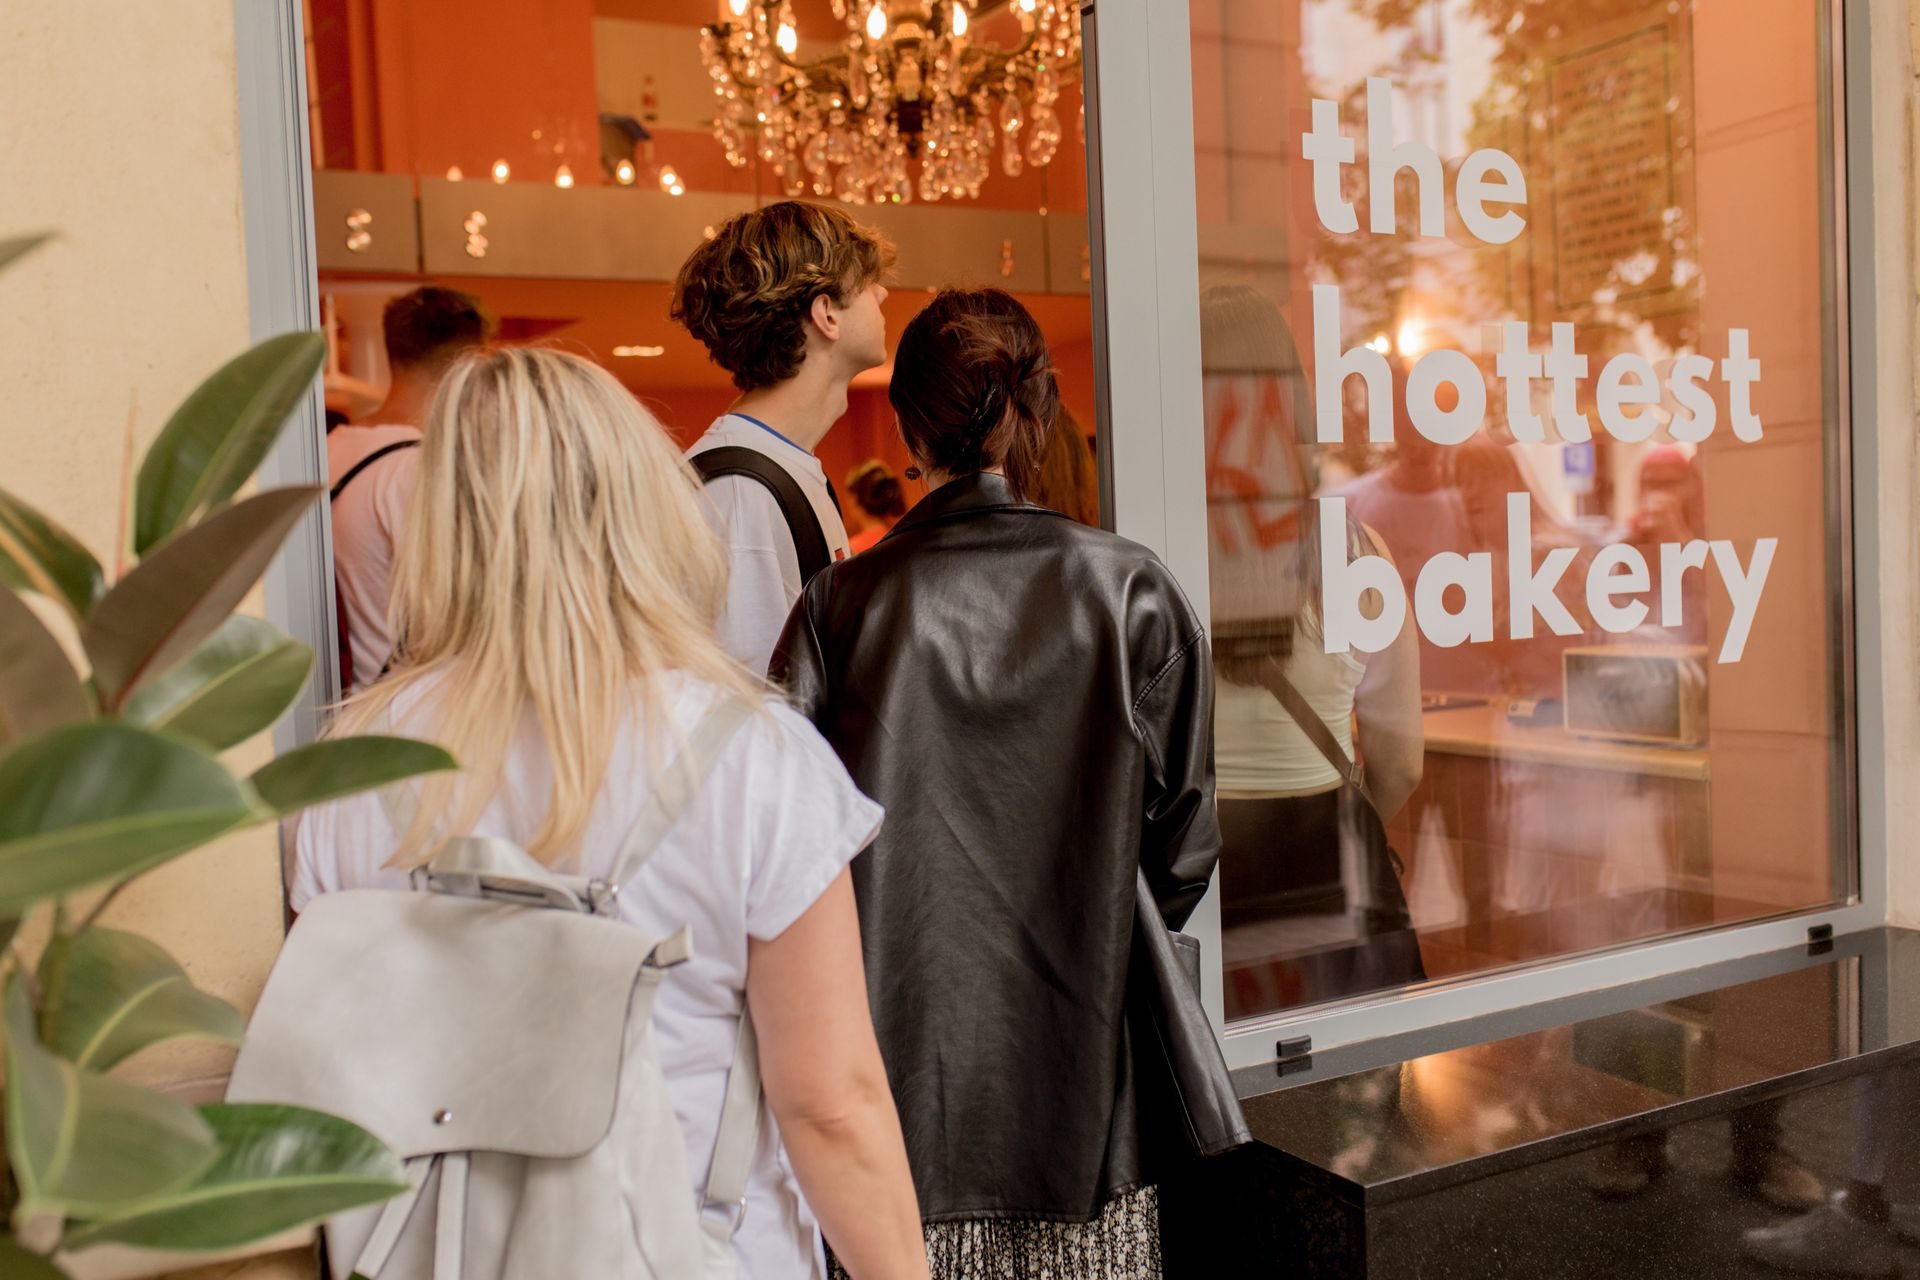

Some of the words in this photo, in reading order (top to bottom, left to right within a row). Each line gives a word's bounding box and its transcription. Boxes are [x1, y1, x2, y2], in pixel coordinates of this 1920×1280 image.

[1302, 77, 1527, 244] the
[1312, 284, 1763, 445] hottest
[1319, 492, 1778, 663] bakery
